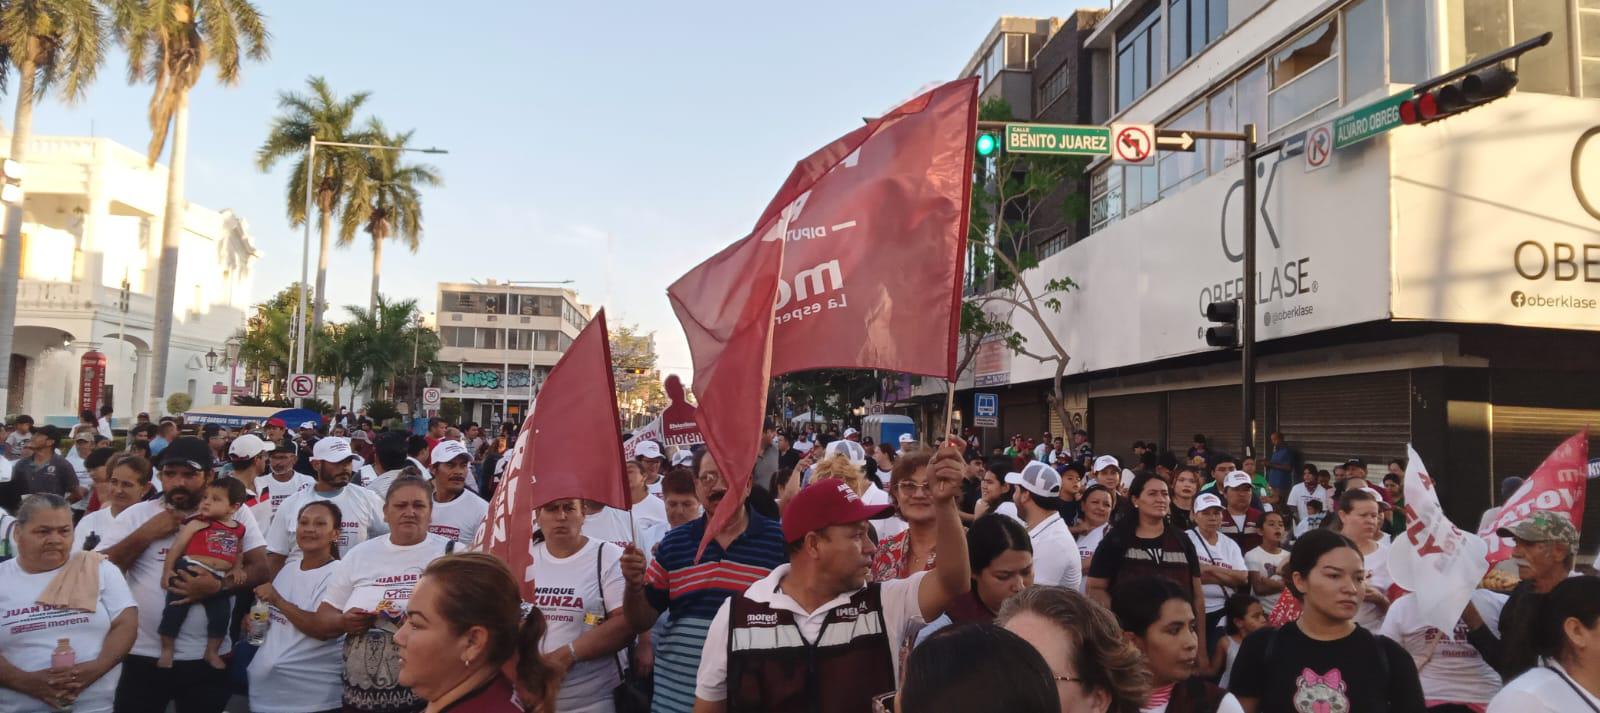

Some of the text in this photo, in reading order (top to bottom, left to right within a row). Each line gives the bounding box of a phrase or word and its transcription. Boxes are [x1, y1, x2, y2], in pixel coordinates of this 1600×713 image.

[1337, 117, 1368, 143] ALVARO
[1010, 133, 1107, 150] BENITO JUAREZ
[1527, 293, 1597, 309] oberklase
[535, 595, 583, 609] UNZA
[2, 604, 41, 619] JUAN
[48, 616, 89, 629] morena
